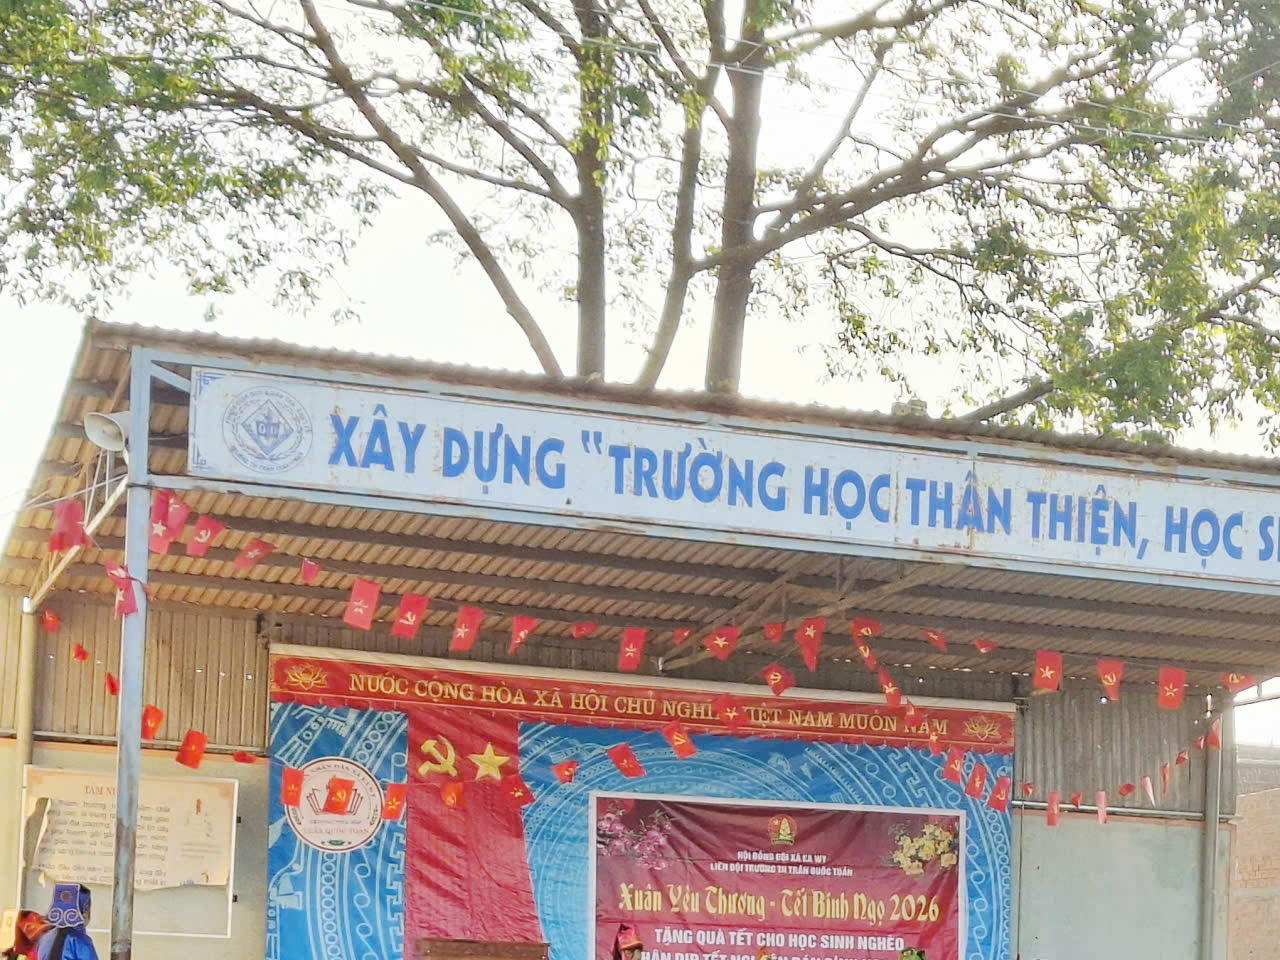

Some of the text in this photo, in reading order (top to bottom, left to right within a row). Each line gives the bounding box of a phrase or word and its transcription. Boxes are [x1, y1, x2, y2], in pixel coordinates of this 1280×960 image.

[328, 404, 426, 473] XÂY
[443, 423, 565, 494] DỰNG
[803, 465, 891, 530] HỌC
[906, 471, 1011, 535] THÂN
[1027, 484, 1149, 559] THIỆN,
[1164, 505, 1243, 569] HỌC
[349, 673, 408, 696] NƯỚC
[415, 675, 474, 702] CỘNG
[480, 680, 526, 705] HÒA
[533, 687, 563, 708] XÃ
[570, 688, 609, 713] HỘI
[614, 690, 656, 715] CHỦ
[742, 702, 782, 728] IỆT
[788, 709, 836, 728] NAM
[840, 709, 897, 732] MUÔN
[618, 883, 662, 911] Xuân
[666, 884, 700, 913] Yêu
[705, 886, 765, 921] Thương
[780, 888, 808, 917] Tết
[812, 889, 848, 921] Bính
[853, 892, 885, 927] Ngọ
[889, 894, 940, 922] 2026
[655, 926, 904, 951] TẶNG QUÀ TẾT CHO HỌC SINH NGHÈO
